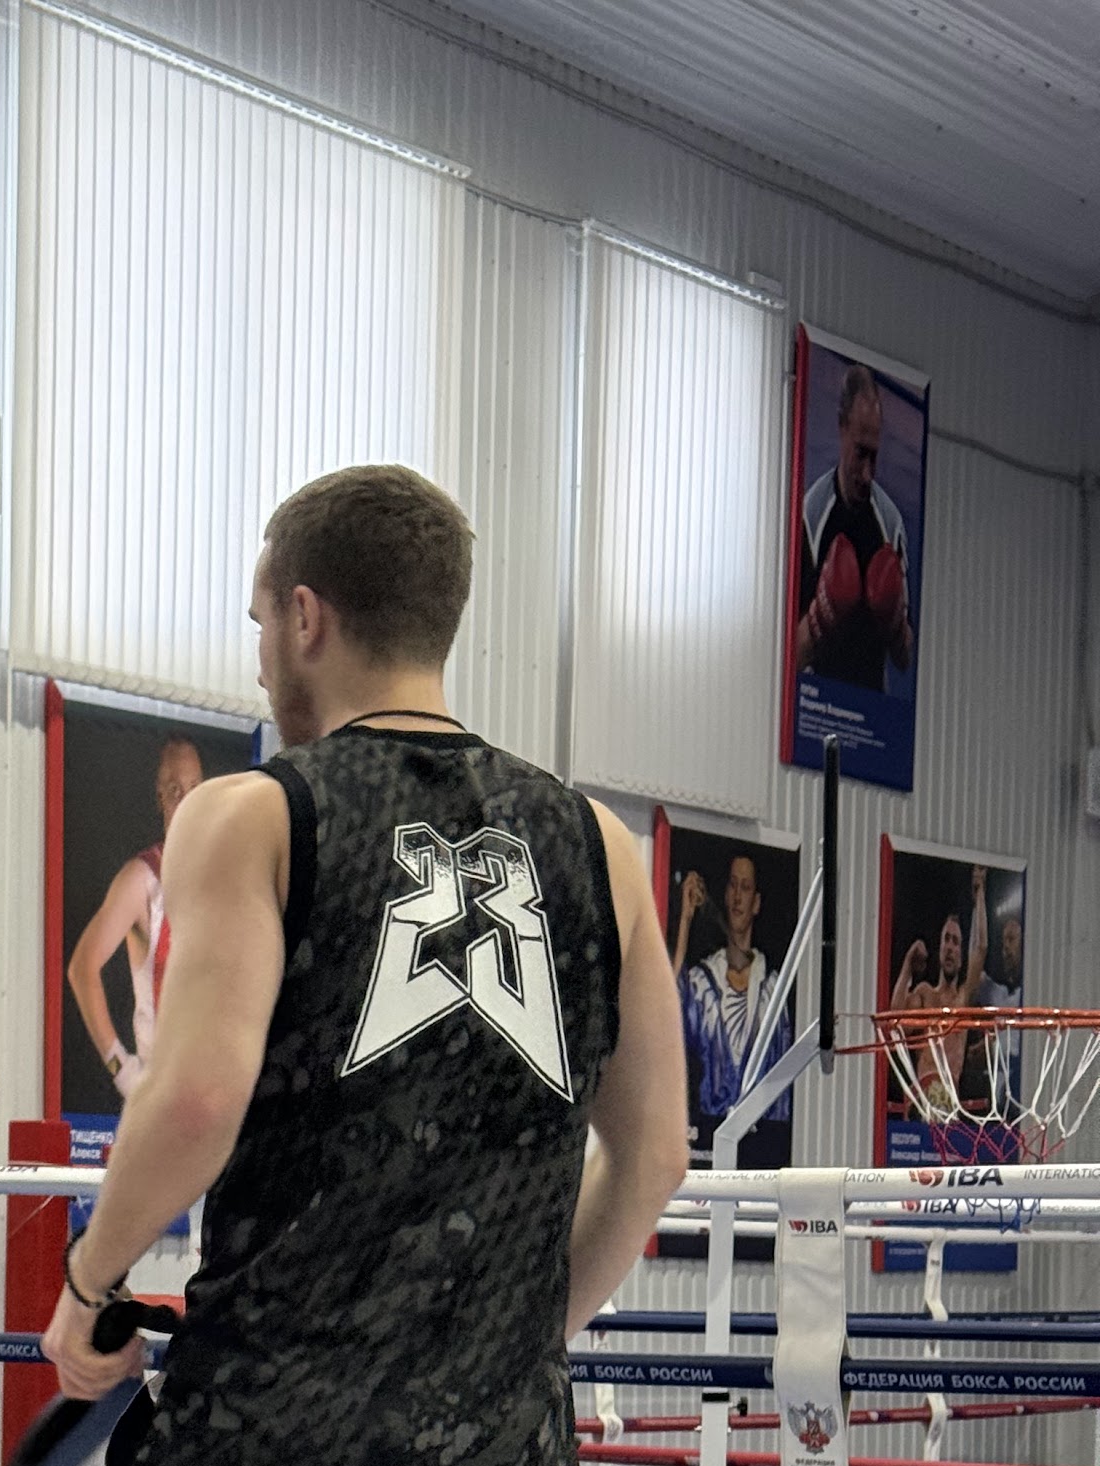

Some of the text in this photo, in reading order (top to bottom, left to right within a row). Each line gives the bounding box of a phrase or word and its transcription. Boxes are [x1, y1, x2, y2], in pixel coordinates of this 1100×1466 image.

[947, 1168, 1004, 1187] IBA
[810, 1219, 838, 1234] IBA
[0, 1344, 40, 1358] БОКСА
[594, 1365, 646, 1380] БОКСА
[649, 1367, 714, 1382] РОССИИ
[843, 1372, 1087, 1391] ФЕДЕРАЦИЯ БОКСА РОССИИ
